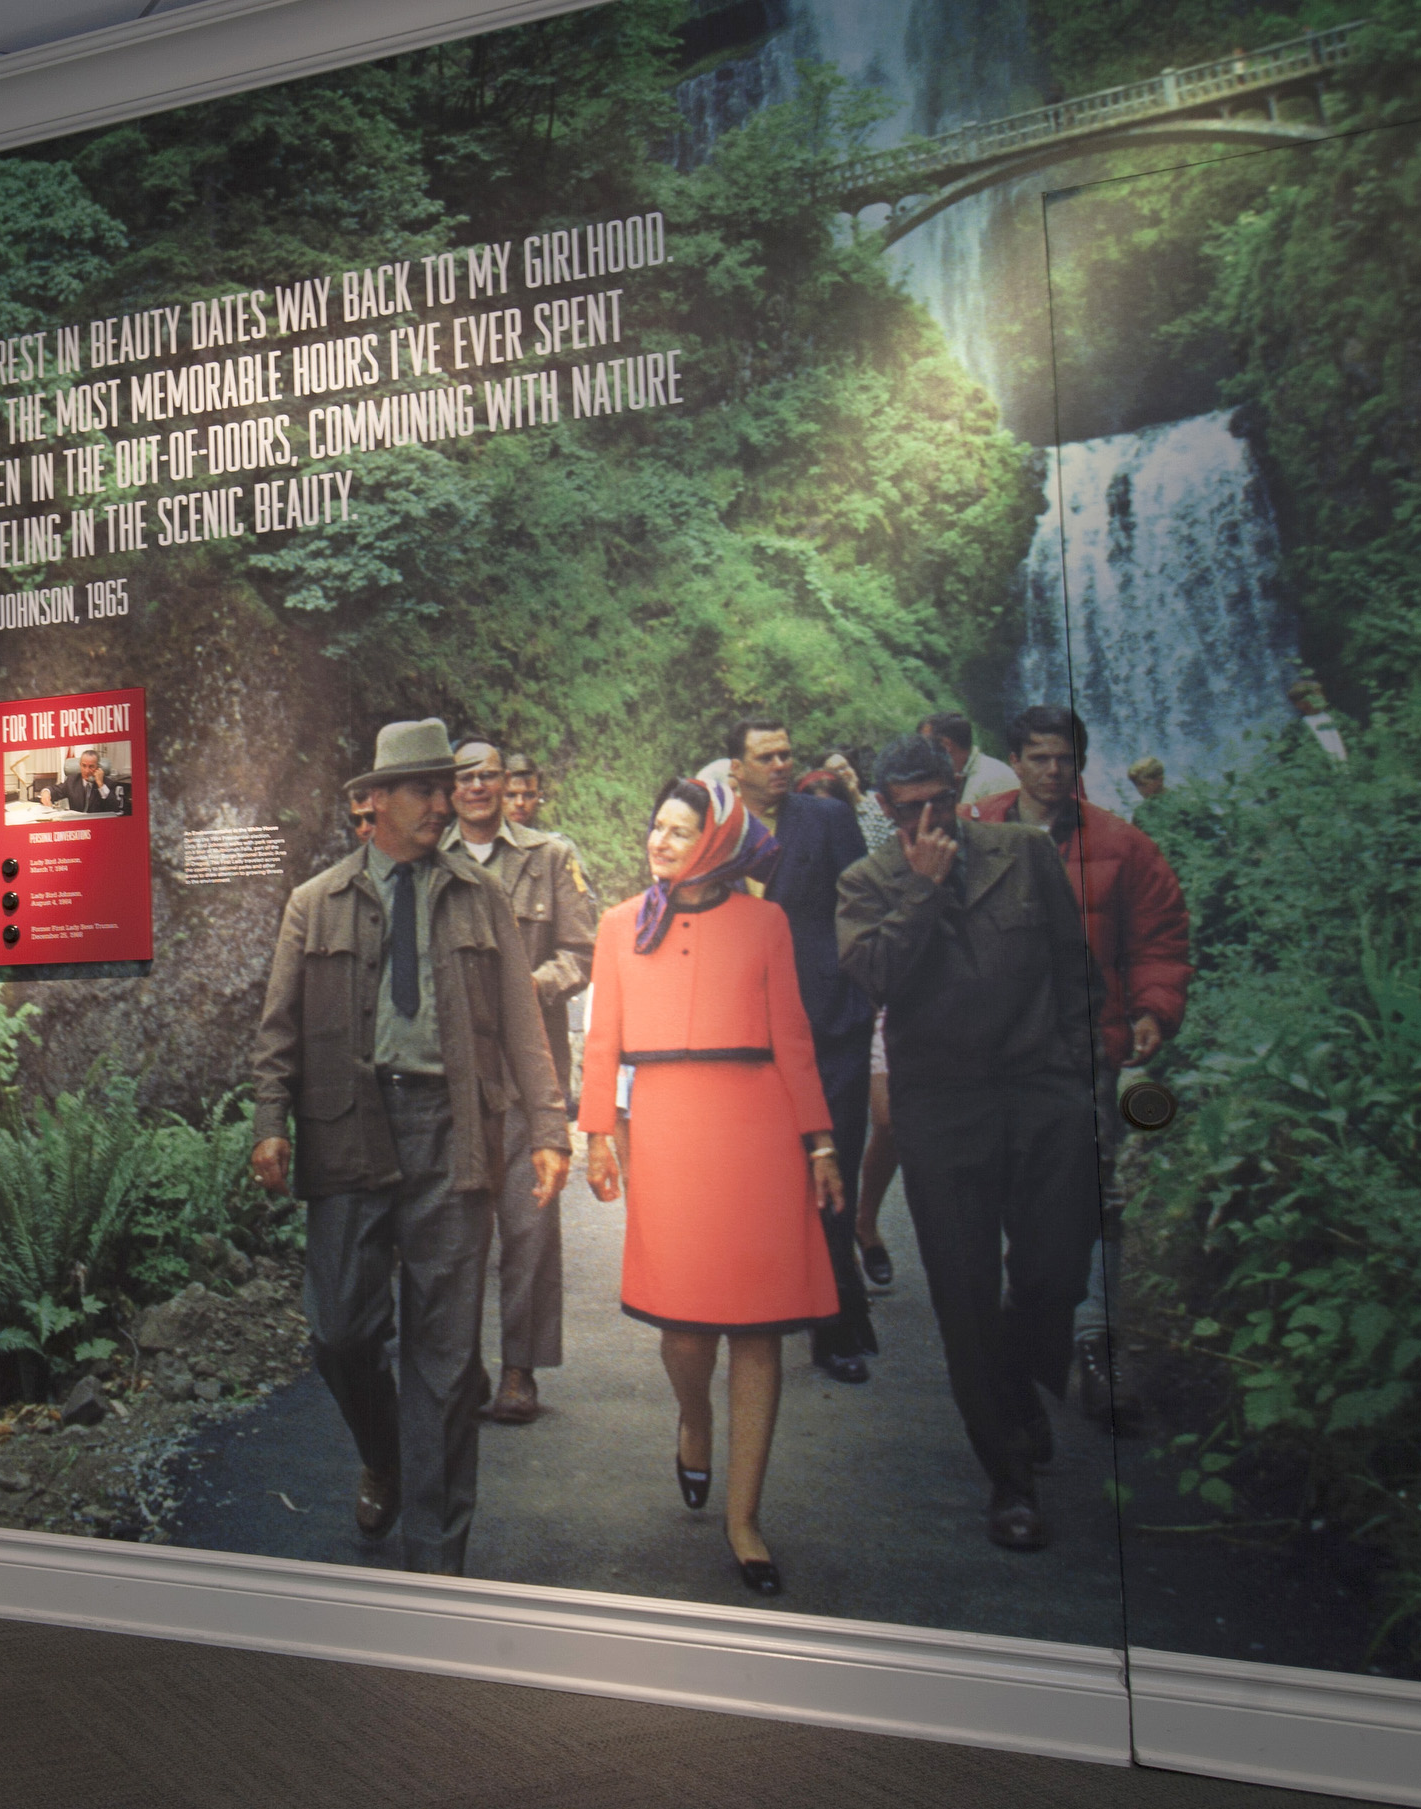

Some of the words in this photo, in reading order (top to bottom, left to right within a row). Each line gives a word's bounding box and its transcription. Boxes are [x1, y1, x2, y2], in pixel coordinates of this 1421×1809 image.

[57, 325, 80, 375] IN
[91, 305, 181, 369] BEAUTY
[192, 290, 266, 350] DATES
[276, 276, 331, 333] WAY
[343, 260, 413, 323] BACK
[421, 253, 455, 307] TO
[467, 241, 512, 299] MY
[524, 211, 674, 289] GIRLHOOD.
[6, 393, 46, 444] THE
[56, 379, 121, 436] MOST
[131, 350, 282, 424] MEMORABLE
[293, 333, 379, 397] HOURS
[390, 322, 442, 380] I'VE
[453, 308, 524, 370] EVER
[534, 289, 623, 355] SPENT
[31, 452, 54, 502] IN
[63, 444, 106, 497] THE
[116, 414, 298, 489] OUT-OF-DOORS,
[309, 384, 474, 460] COMMUNING
[484, 370, 559, 433] WITH
[571, 349, 684, 420] NATURE
[71, 508, 95, 558] IN
[104, 500, 148, 554] THE
[158, 486, 245, 547] SCENIC
[255, 470, 358, 534] BEAUTY.
[85, 578, 129, 619] 1965
[2, 714, 27, 743] FOR
[31, 711, 55, 740] THE
[60, 703, 131, 739] PRESIDENT
